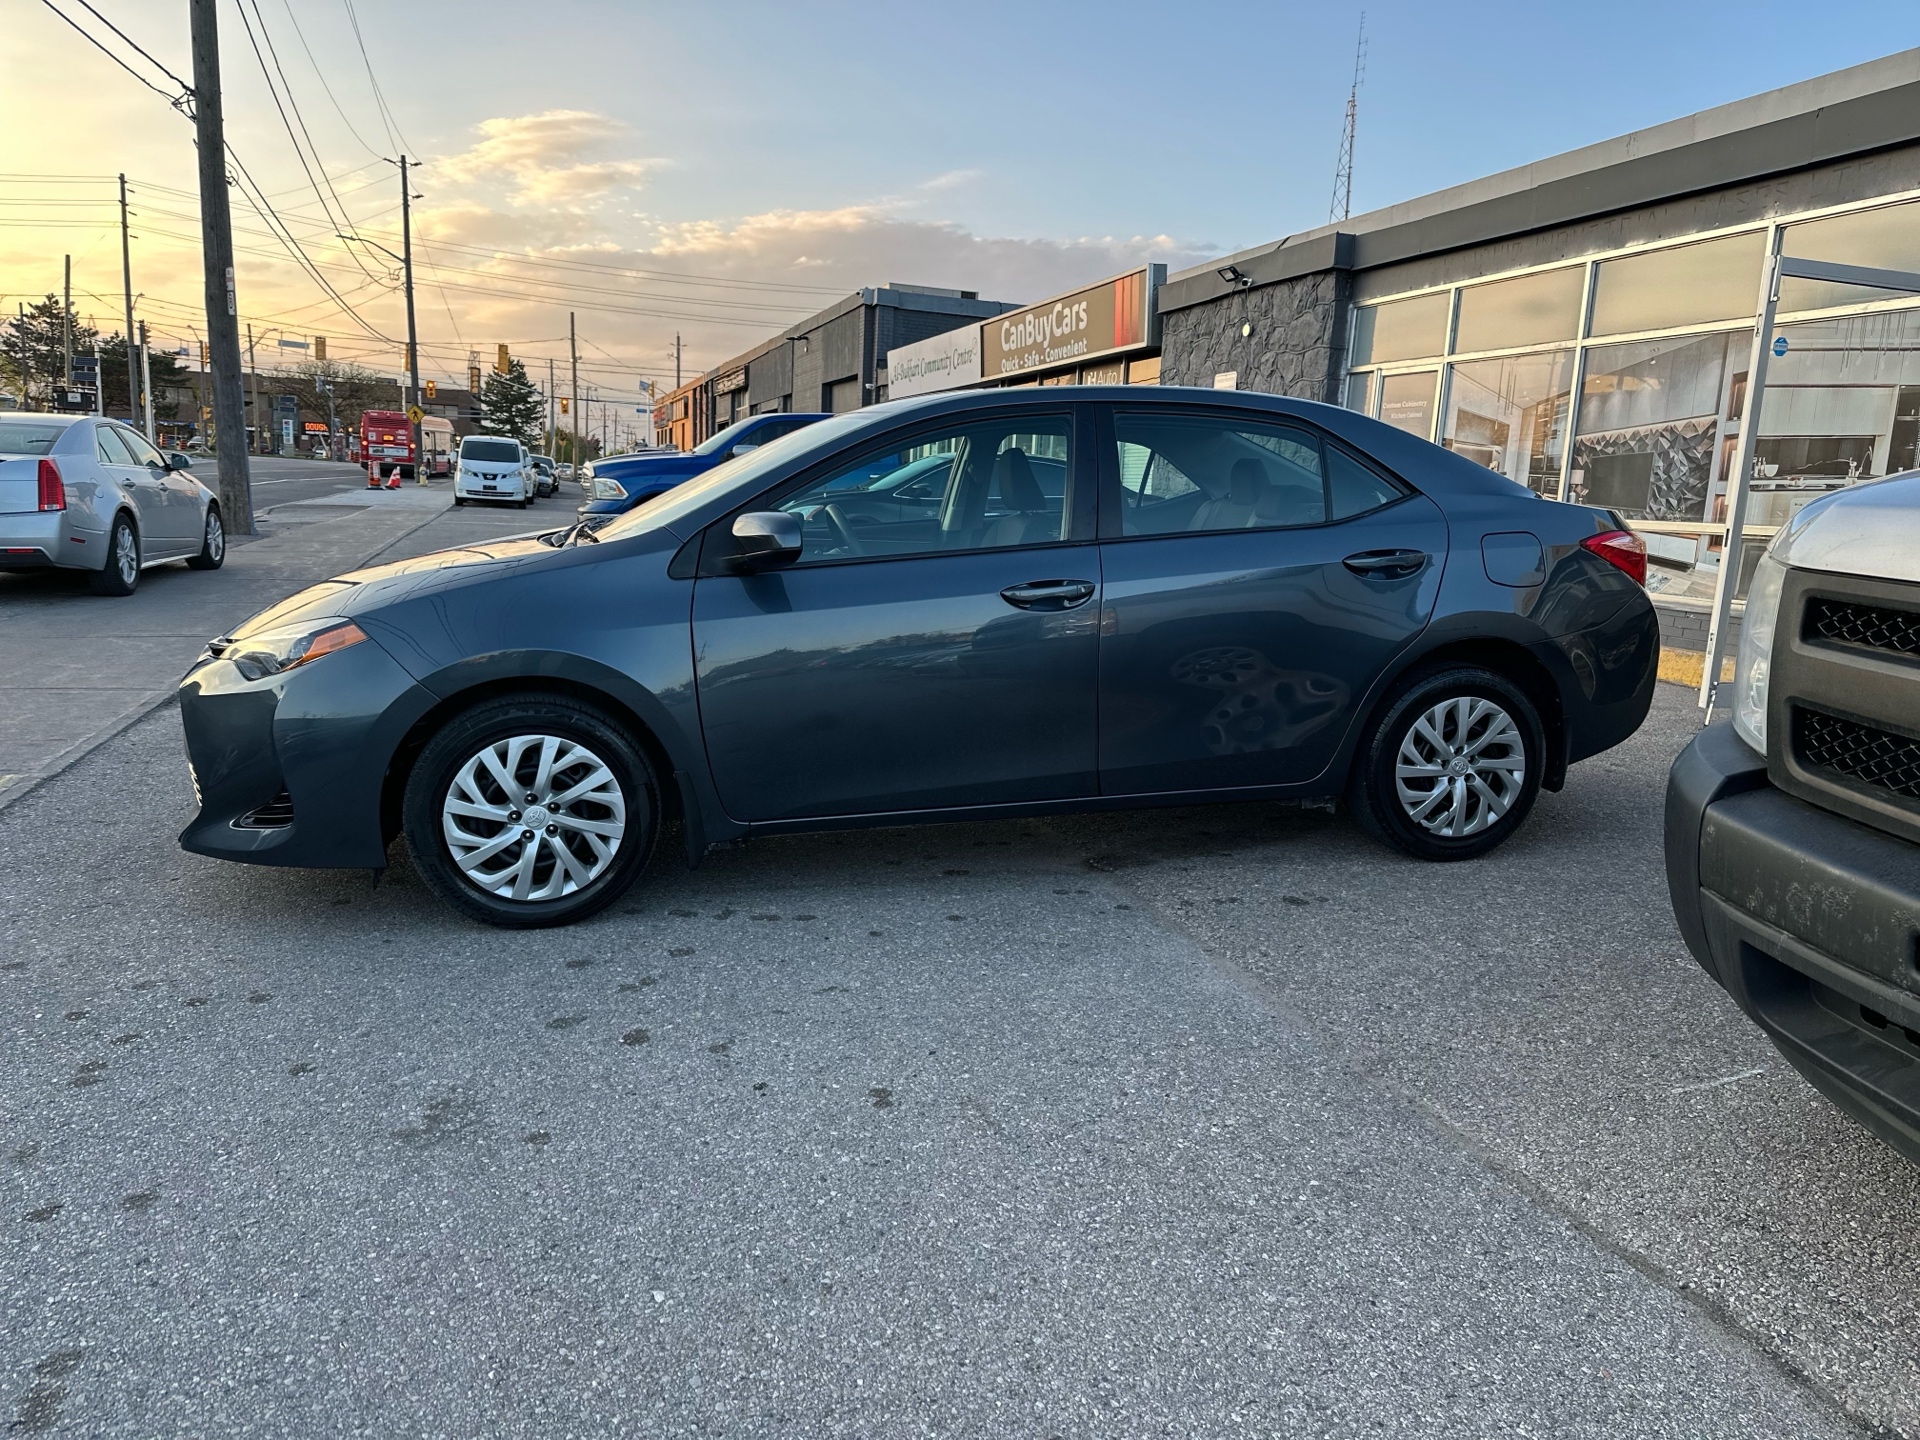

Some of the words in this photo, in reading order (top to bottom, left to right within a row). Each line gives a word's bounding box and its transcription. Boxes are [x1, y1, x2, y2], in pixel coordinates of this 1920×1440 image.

[1001, 301, 1088, 352] CanBuyCars
[921, 350, 951, 377] Community
[953, 344, 976, 369] Centre
[1001, 356, 1019, 373] Quick
[1024, 350, 1040, 368] Safe
[1045, 337, 1088, 362] Convenient
